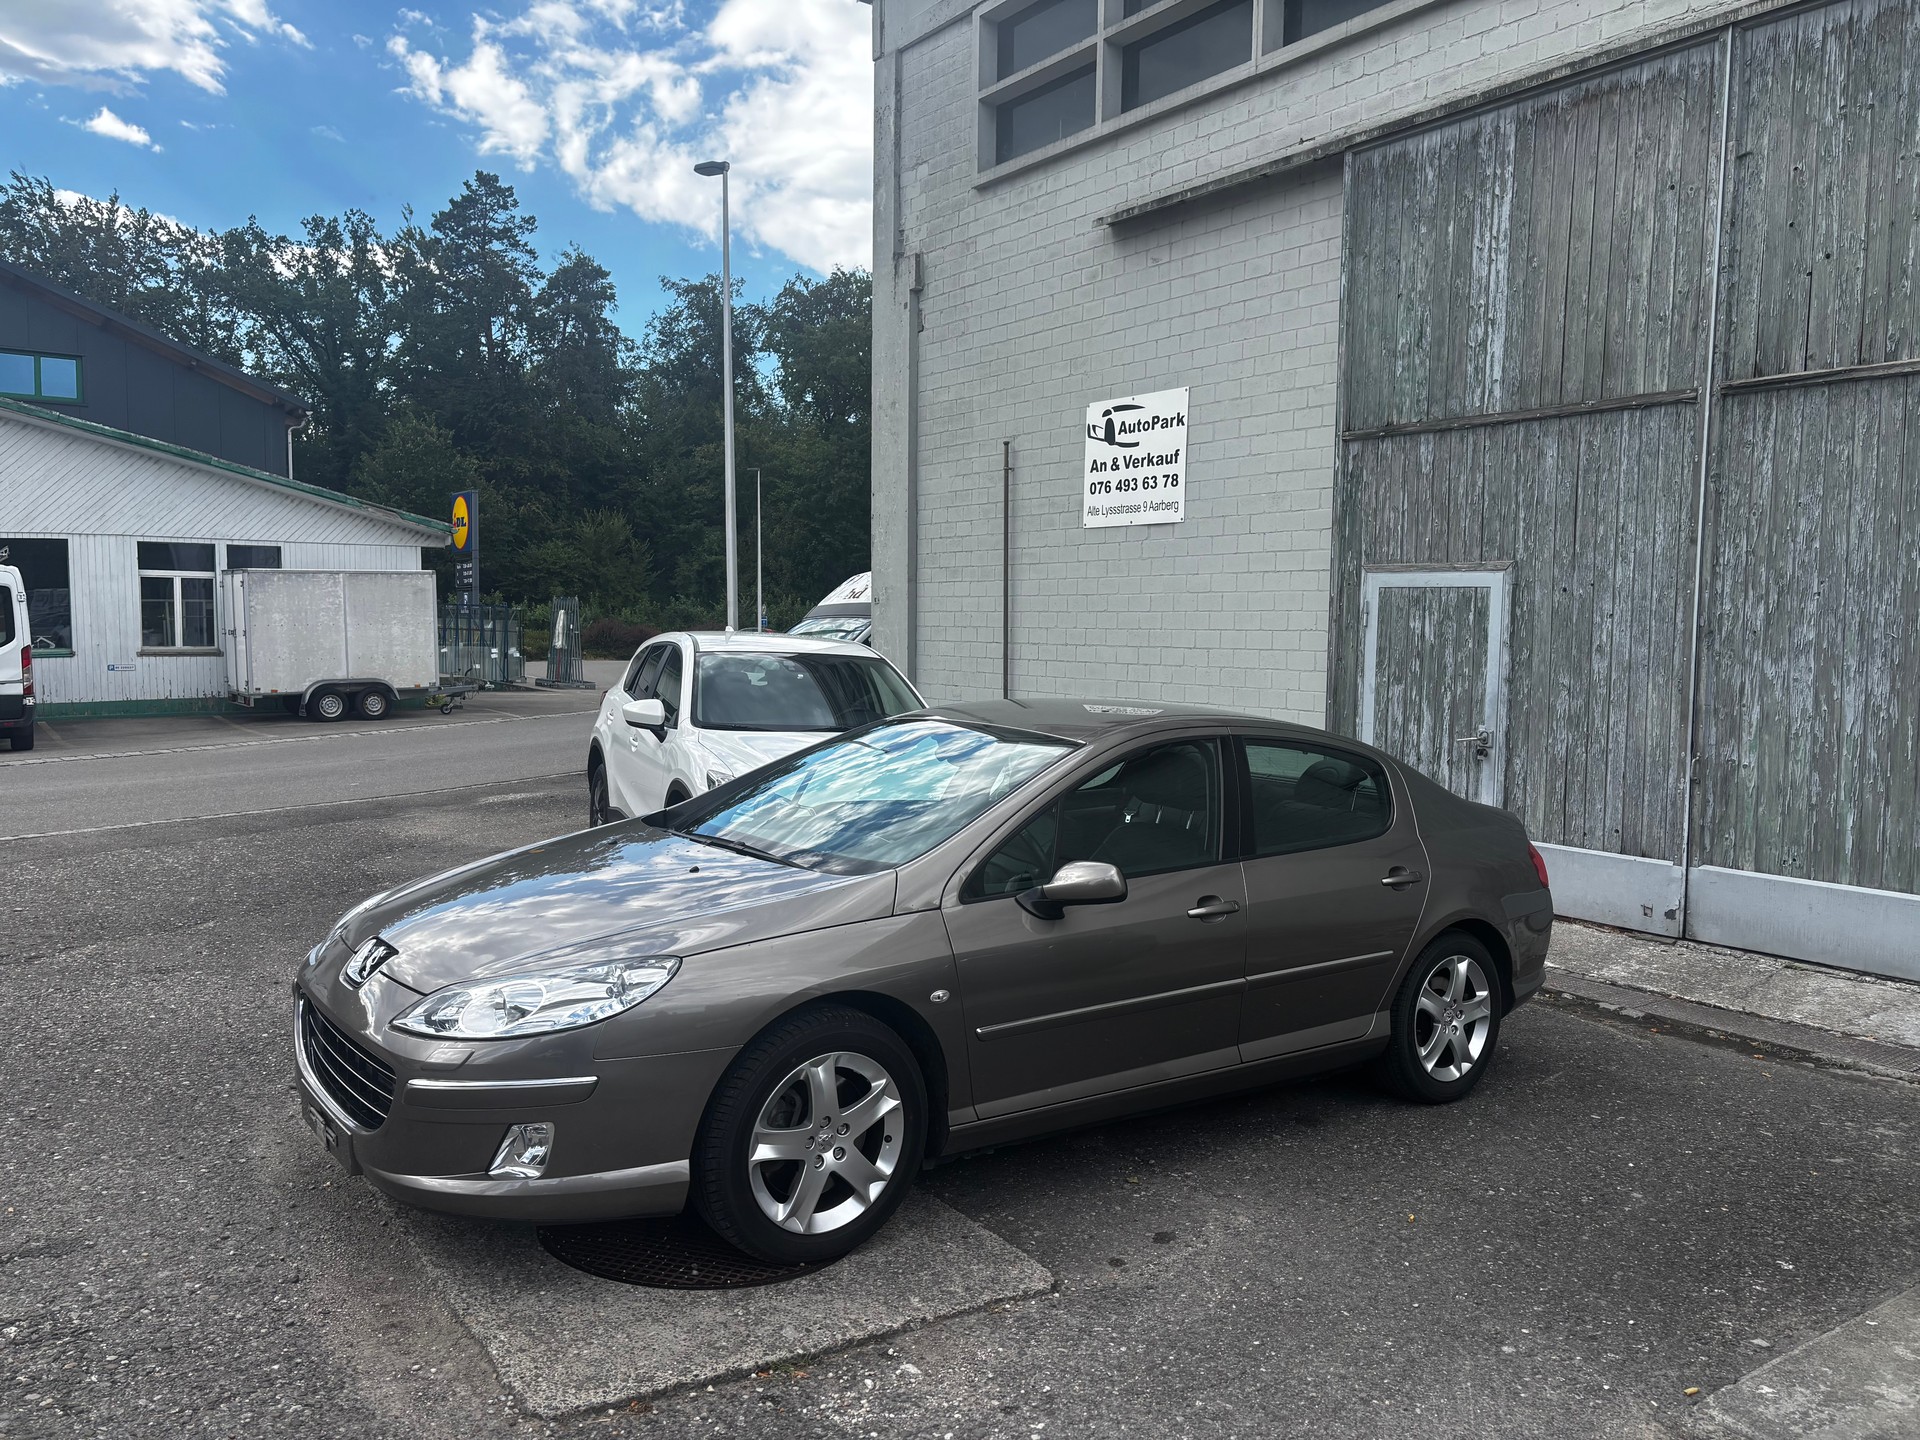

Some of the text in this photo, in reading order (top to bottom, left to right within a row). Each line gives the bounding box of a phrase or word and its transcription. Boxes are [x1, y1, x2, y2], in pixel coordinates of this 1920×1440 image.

[1118, 412, 1186, 436] AutoPark
[1089, 448, 1181, 474] An & Verkauf
[1089, 473, 1179, 496] 076 493 63 78
[1087, 500, 1179, 518] Alte Lyssstrasse 9 Aarberg
